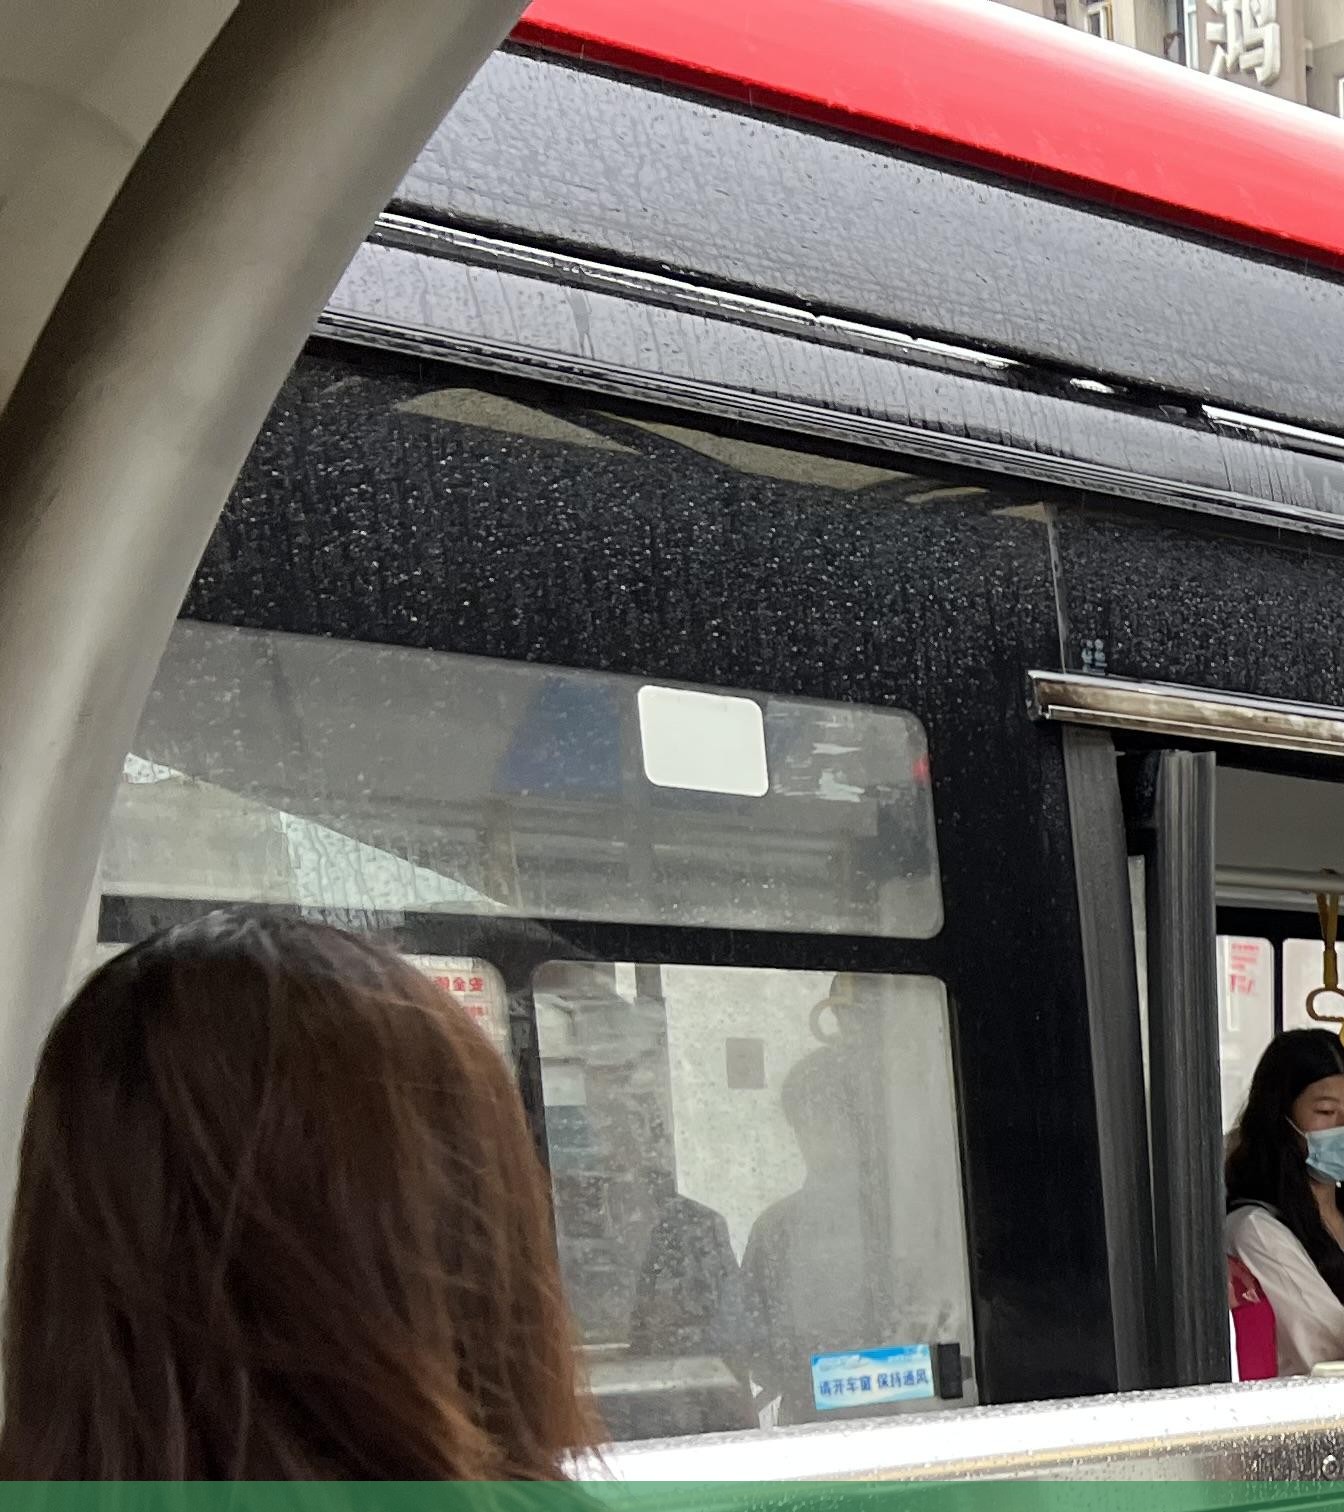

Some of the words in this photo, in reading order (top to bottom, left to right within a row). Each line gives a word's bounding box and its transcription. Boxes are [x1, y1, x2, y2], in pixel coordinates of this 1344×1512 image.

[818, 1374, 872, 1396] 请开车窗
[877, 1368, 929, 1388] 保持通风
